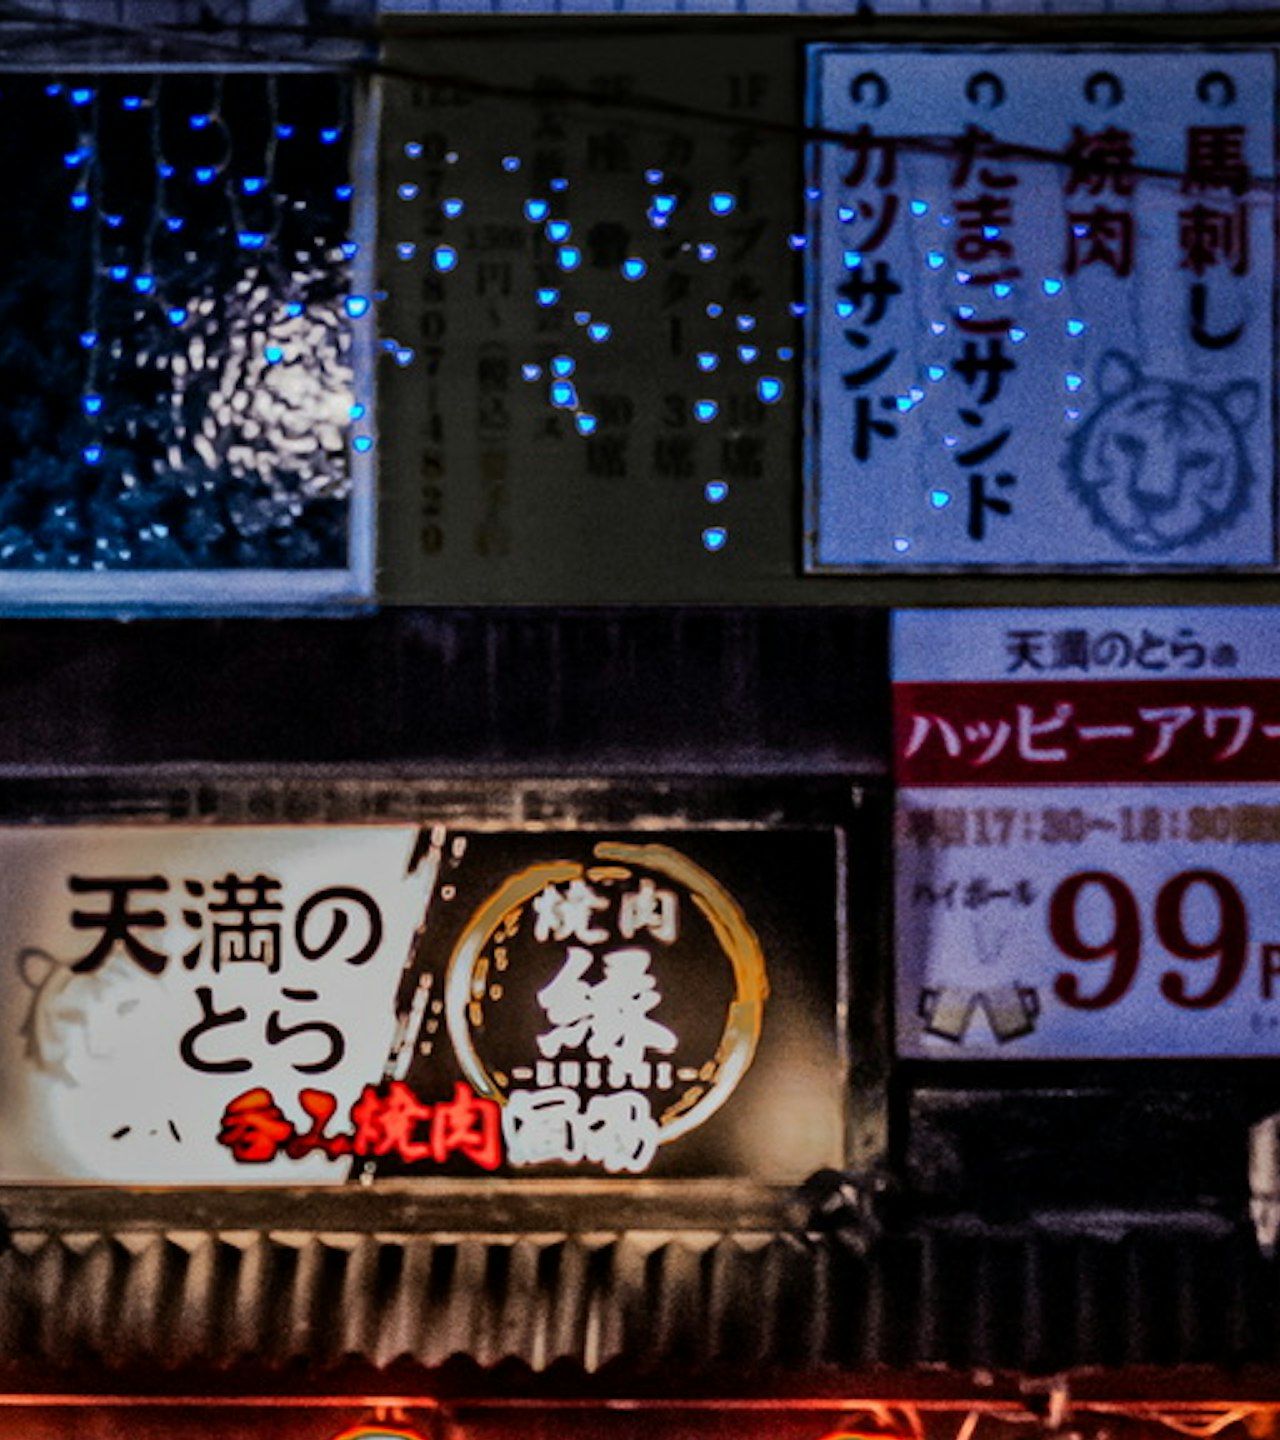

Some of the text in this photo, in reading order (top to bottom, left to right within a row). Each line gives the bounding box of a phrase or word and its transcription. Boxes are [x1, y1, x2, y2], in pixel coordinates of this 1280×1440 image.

[1063, 124, 1135, 278] 焼肉
[1178, 124, 1250, 351] 馬刺し
[836, 123, 902, 462] カツサンド
[950, 124, 1022, 541] たまごサンド
[66, 871, 384, 976] 天満の
[532, 877, 680, 945] 焼肉
[179, 985, 346, 1076] とら
